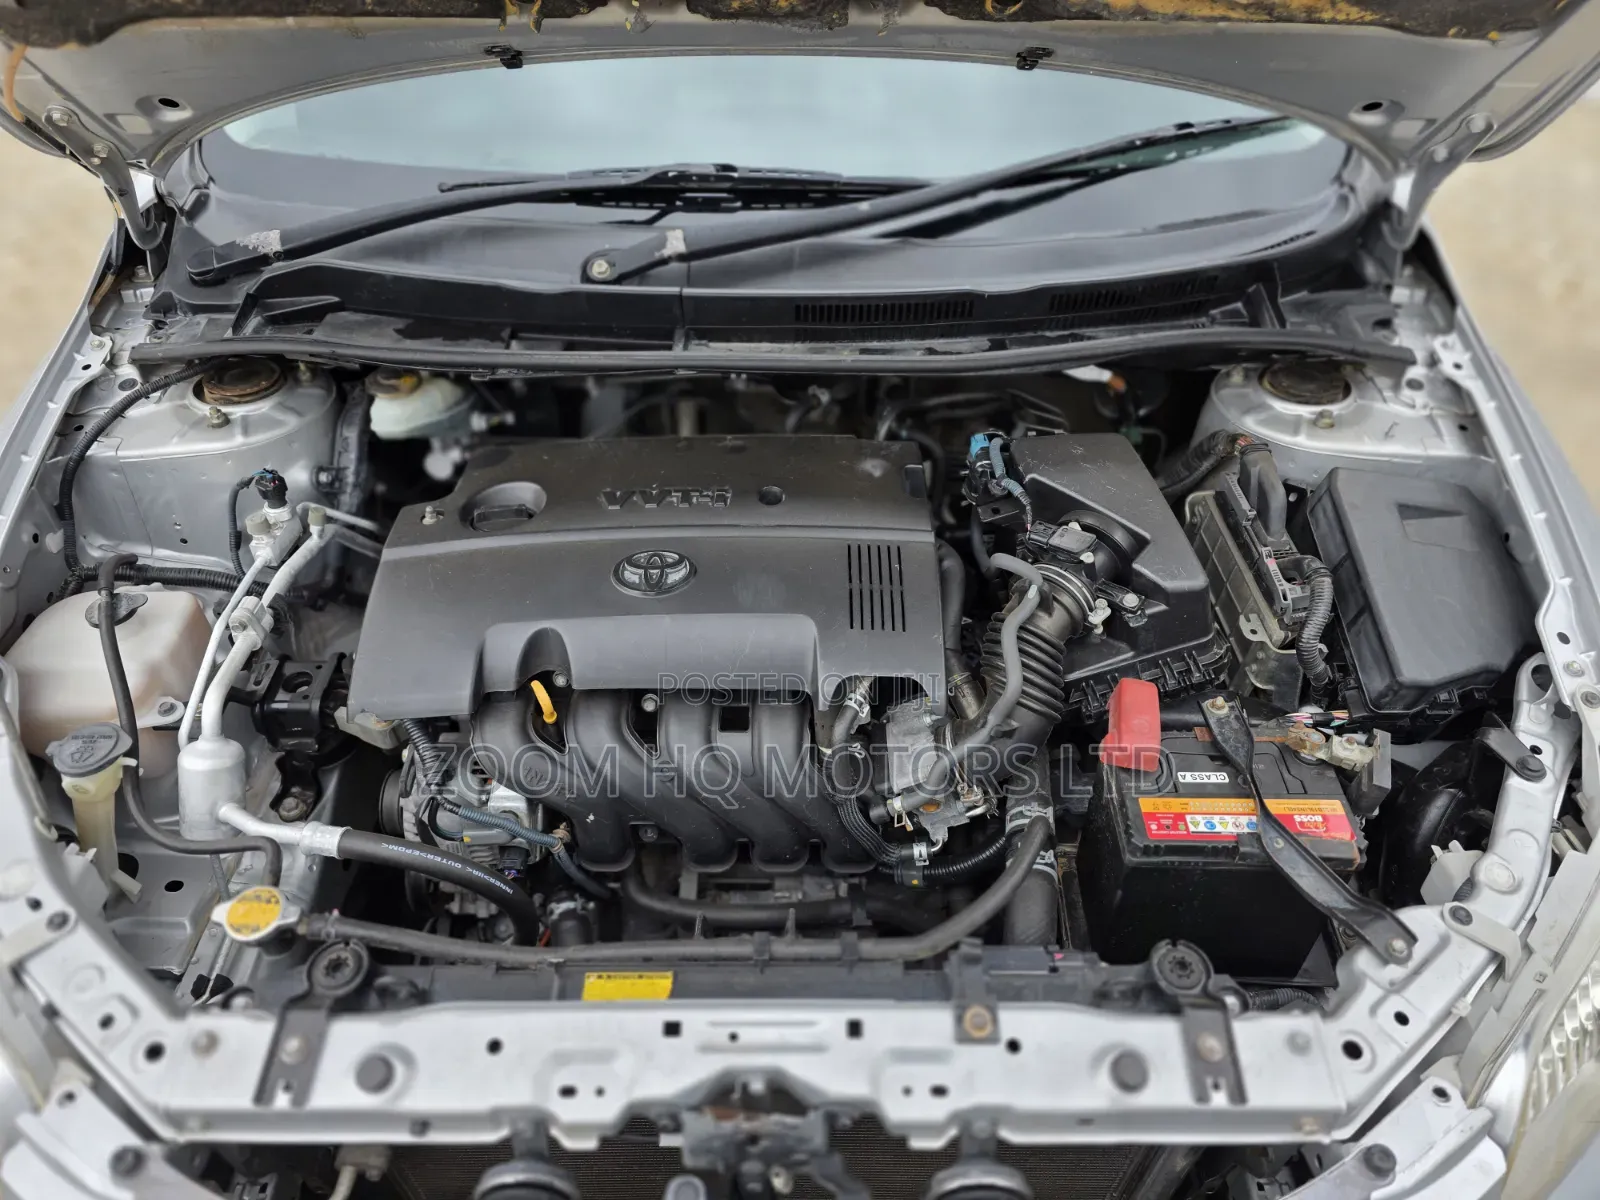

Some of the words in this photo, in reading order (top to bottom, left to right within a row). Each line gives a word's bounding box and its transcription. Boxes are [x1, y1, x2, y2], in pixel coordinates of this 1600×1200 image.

[1179, 773, 1187, 781] A
[1190, 773, 1226, 781] CLASS
[1293, 814, 1323, 823] BOSS
